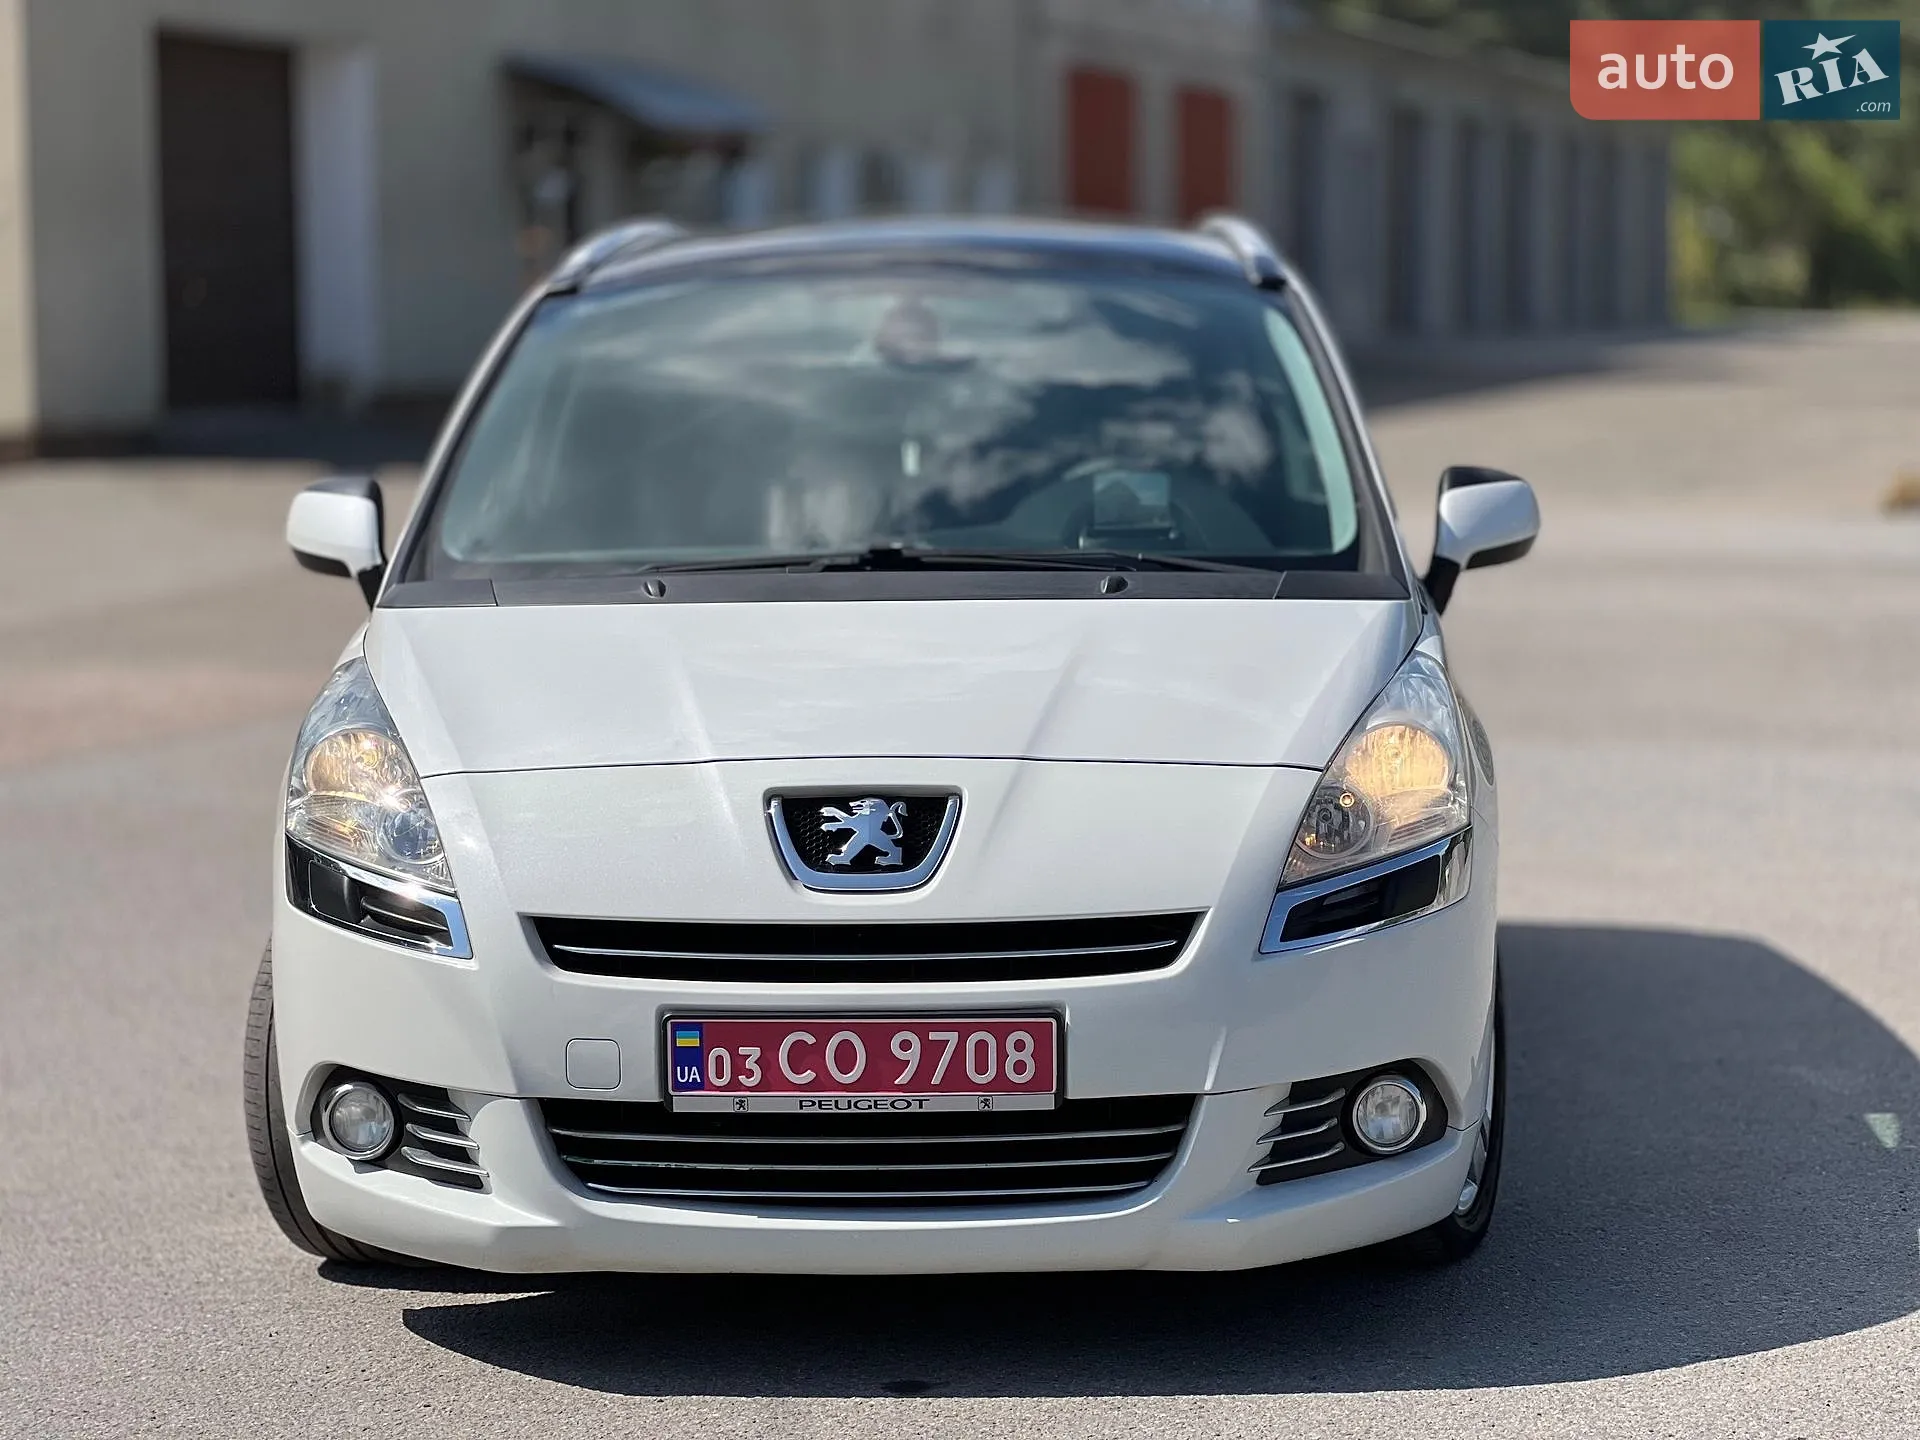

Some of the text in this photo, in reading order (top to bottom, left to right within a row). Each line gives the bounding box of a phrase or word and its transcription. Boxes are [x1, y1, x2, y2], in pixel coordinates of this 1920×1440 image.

[676, 1030, 1036, 1087] UA 03 CO 9708
[798, 1098, 930, 1111] PEUGEOT
